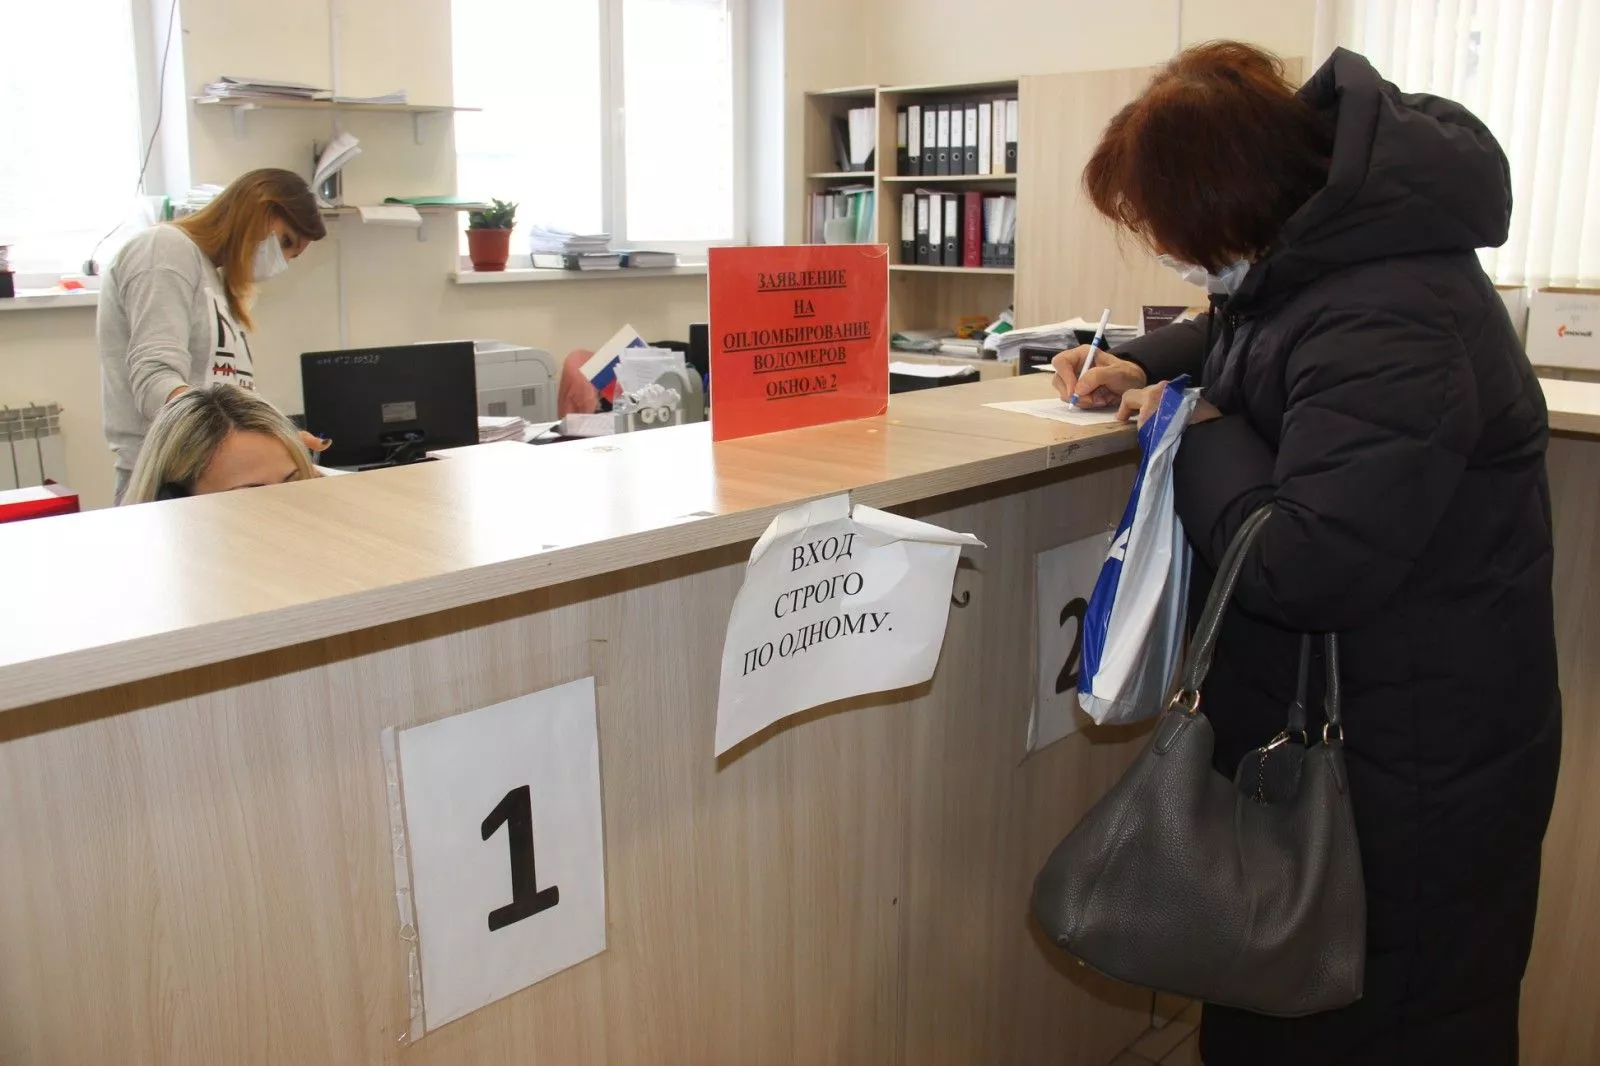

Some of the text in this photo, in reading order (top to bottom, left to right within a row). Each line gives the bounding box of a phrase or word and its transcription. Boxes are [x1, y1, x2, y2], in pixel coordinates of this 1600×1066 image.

[757, 269, 847, 291] ЗАЯВЛЕНИЕ
[793, 299, 816, 316] НА
[723, 321, 871, 351] ОПЛОМБИРОВАНИЕ
[753, 346, 847, 372] ВОДОМЕРОВ
[766, 377, 810, 398] ОКНО
[830, 374, 837, 389] 2
[790, 533, 856, 572] ВХОД
[774, 572, 864, 619] СТРОГО
[742, 612, 893, 676] ПО ОДНОМУ.
[481, 784, 560, 932] 1
